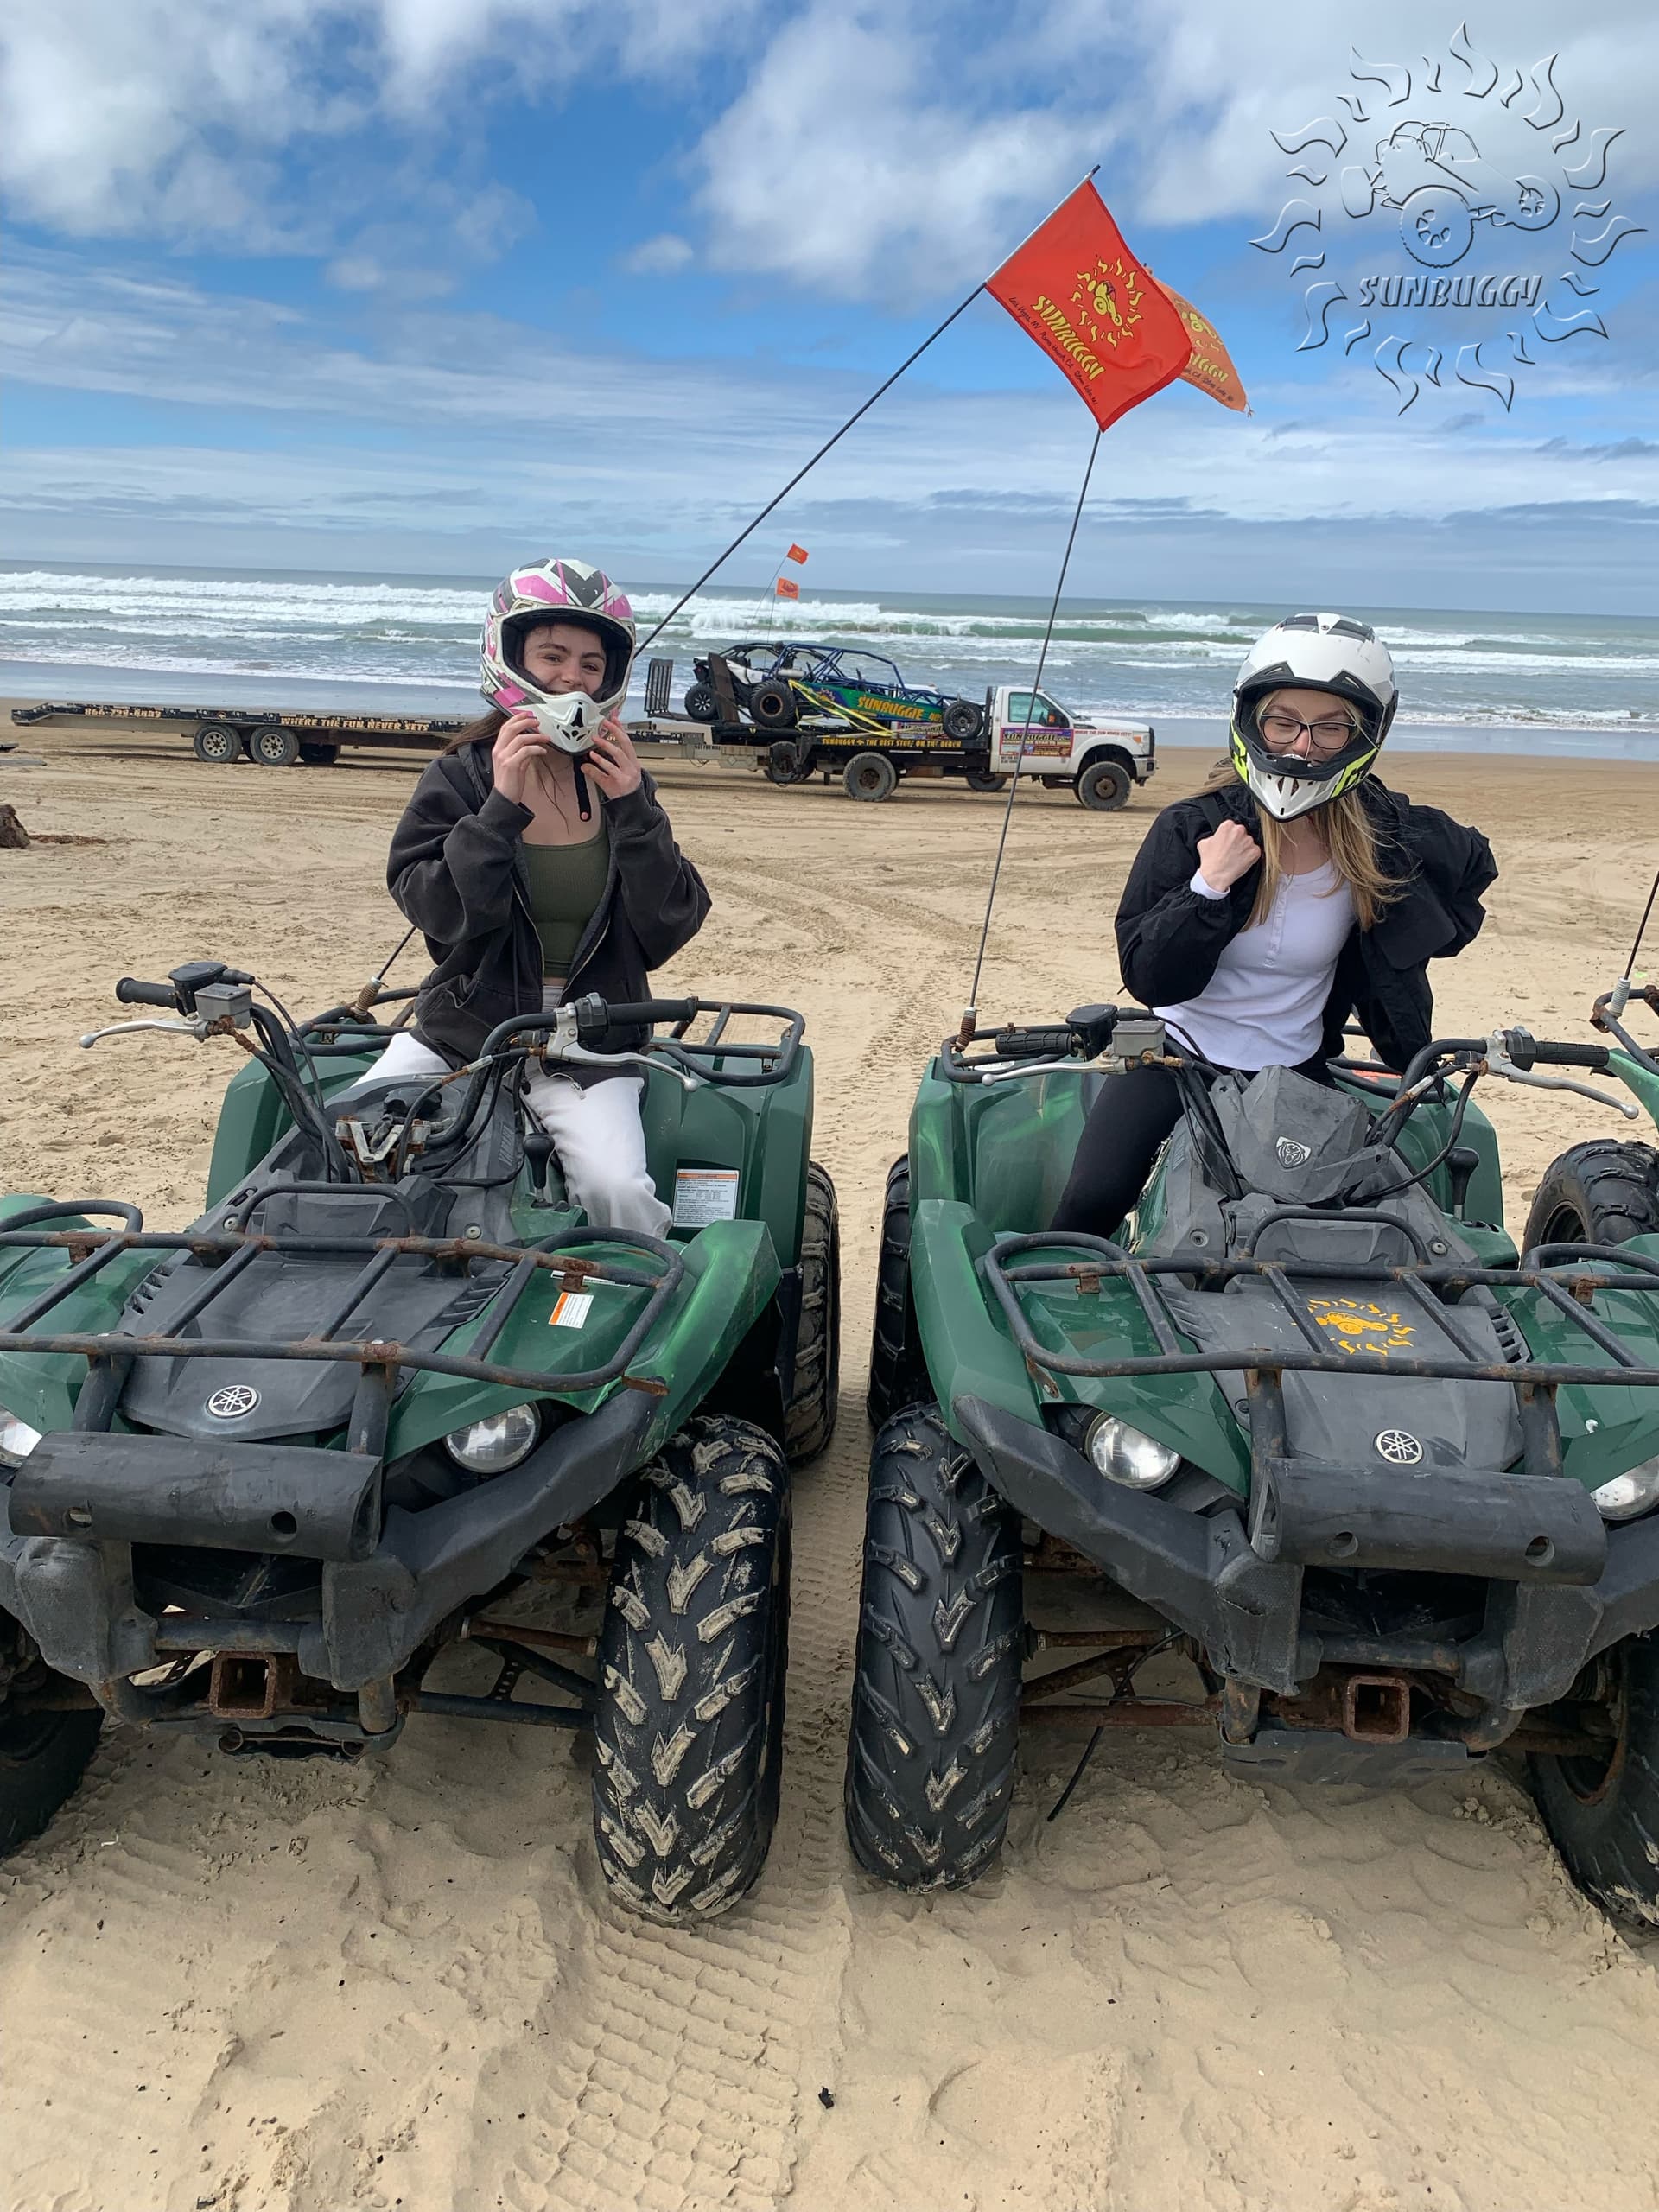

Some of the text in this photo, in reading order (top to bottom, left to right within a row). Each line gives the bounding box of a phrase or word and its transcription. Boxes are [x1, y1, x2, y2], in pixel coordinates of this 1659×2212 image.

[1031, 295, 1105, 381] SUNBUGGY
[280, 717, 429, 732] WHERE THE FUN NEVER SETS
[822, 737, 855, 746] SUNBUGGY
